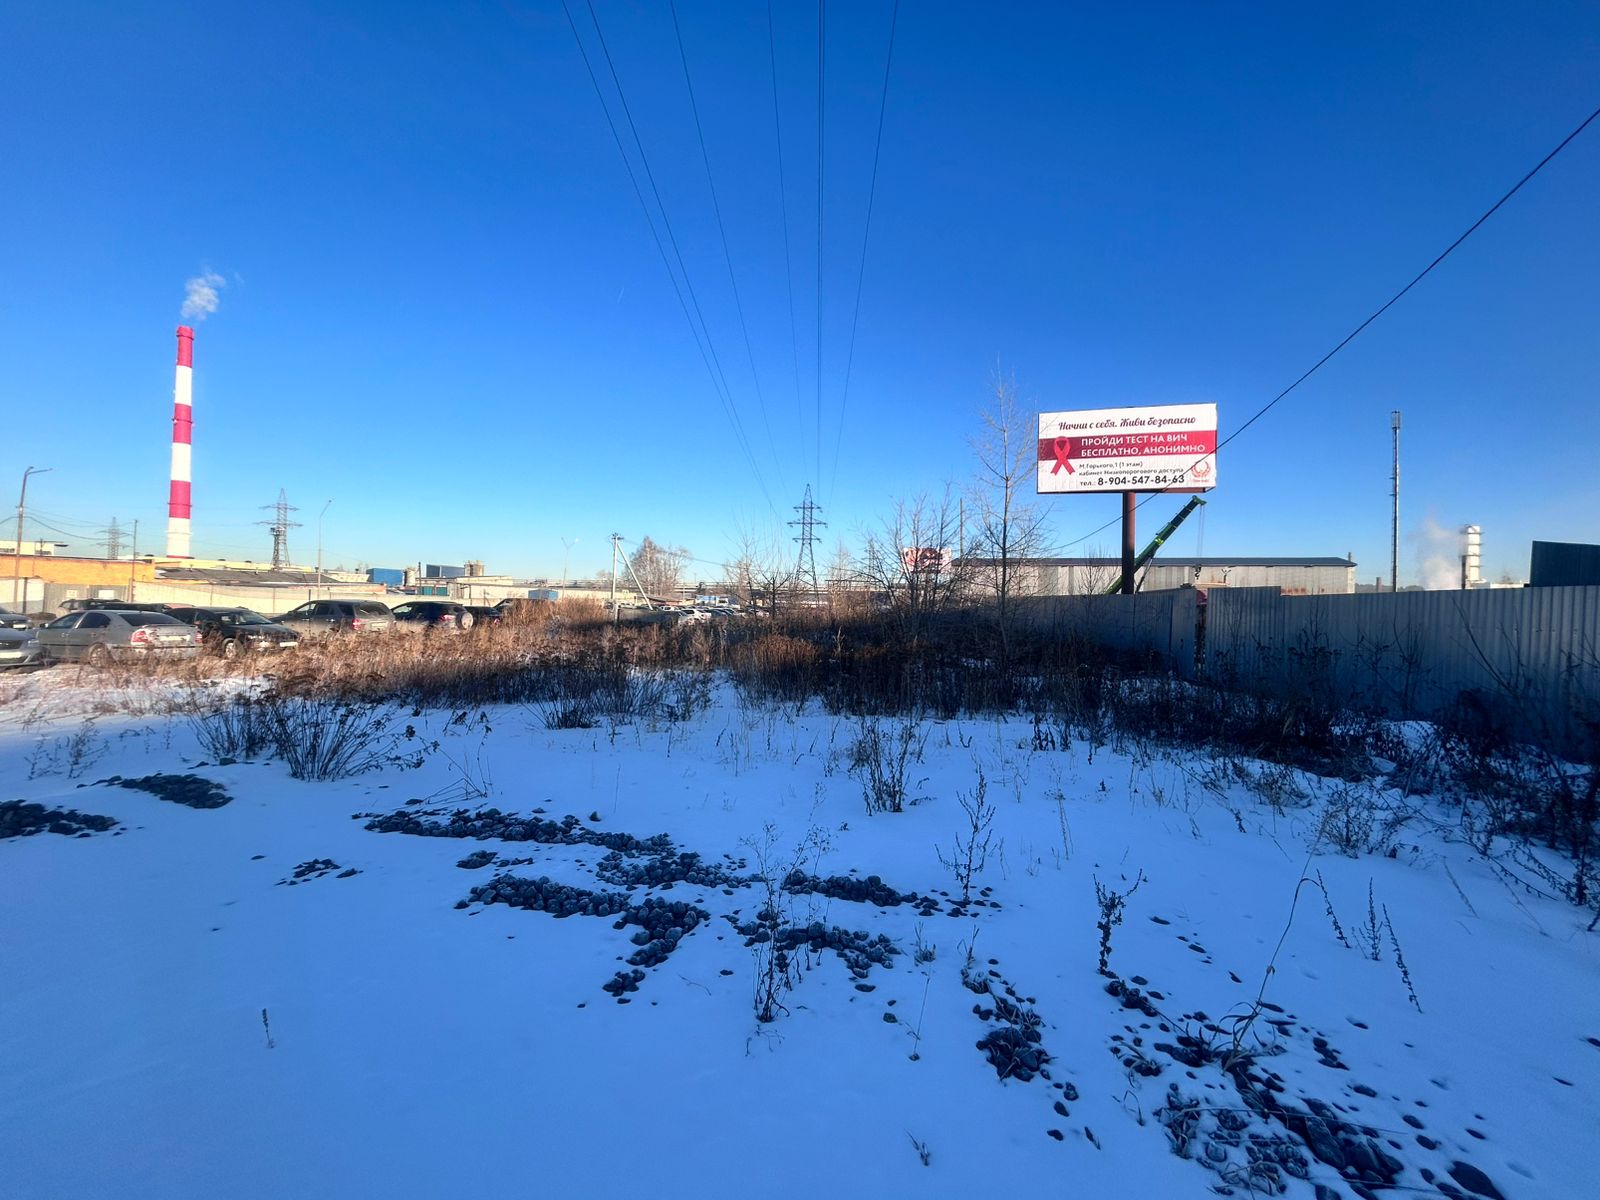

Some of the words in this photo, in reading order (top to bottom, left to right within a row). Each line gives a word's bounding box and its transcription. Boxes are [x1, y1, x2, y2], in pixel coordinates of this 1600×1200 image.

[1058, 422, 1088, 430] Начни
[1096, 420, 1118, 429] себя.
[1120, 418, 1146, 427] Живи
[1148, 416, 1196, 428] безопасно
[1082, 435, 1124, 446] ПРОЙДИ
[1126, 436, 1148, 444] ТЕСТ
[1150, 435, 1164, 443] НА
[1167, 434, 1188, 442] ВИЧ
[1082, 447, 1141, 456] БЕСПЛАТНО,
[1144, 444, 1206, 454] АНОНИМНО
[1098, 474, 1184, 486] 8-904-547-84-63
